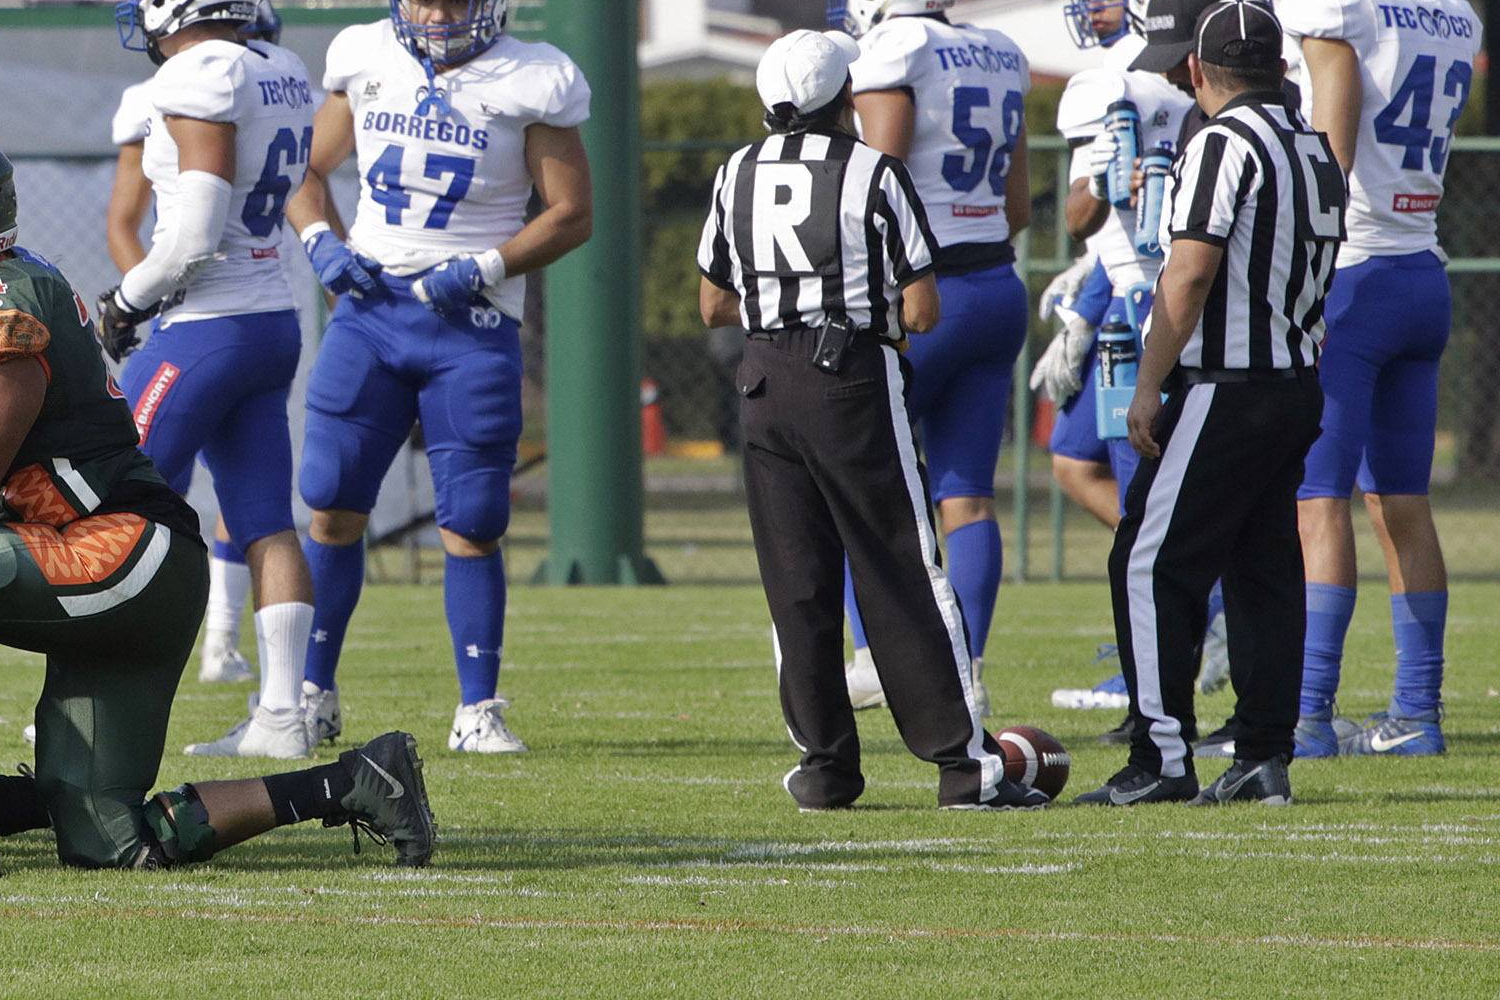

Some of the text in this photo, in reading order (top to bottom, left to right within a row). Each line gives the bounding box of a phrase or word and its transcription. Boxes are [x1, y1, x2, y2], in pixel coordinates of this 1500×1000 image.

[1378, 4, 1418, 30] TEC
[257, 80, 285, 106] TEC
[934, 46, 972, 71] TEC
[363, 111, 489, 150] BORREGOS
[941, 86, 1024, 197] 58
[1373, 54, 1473, 176] 43
[367, 143, 476, 230] 47
[753, 163, 814, 273] R
[1294, 133, 1340, 238] C
[137, 366, 176, 426] BANORTE
